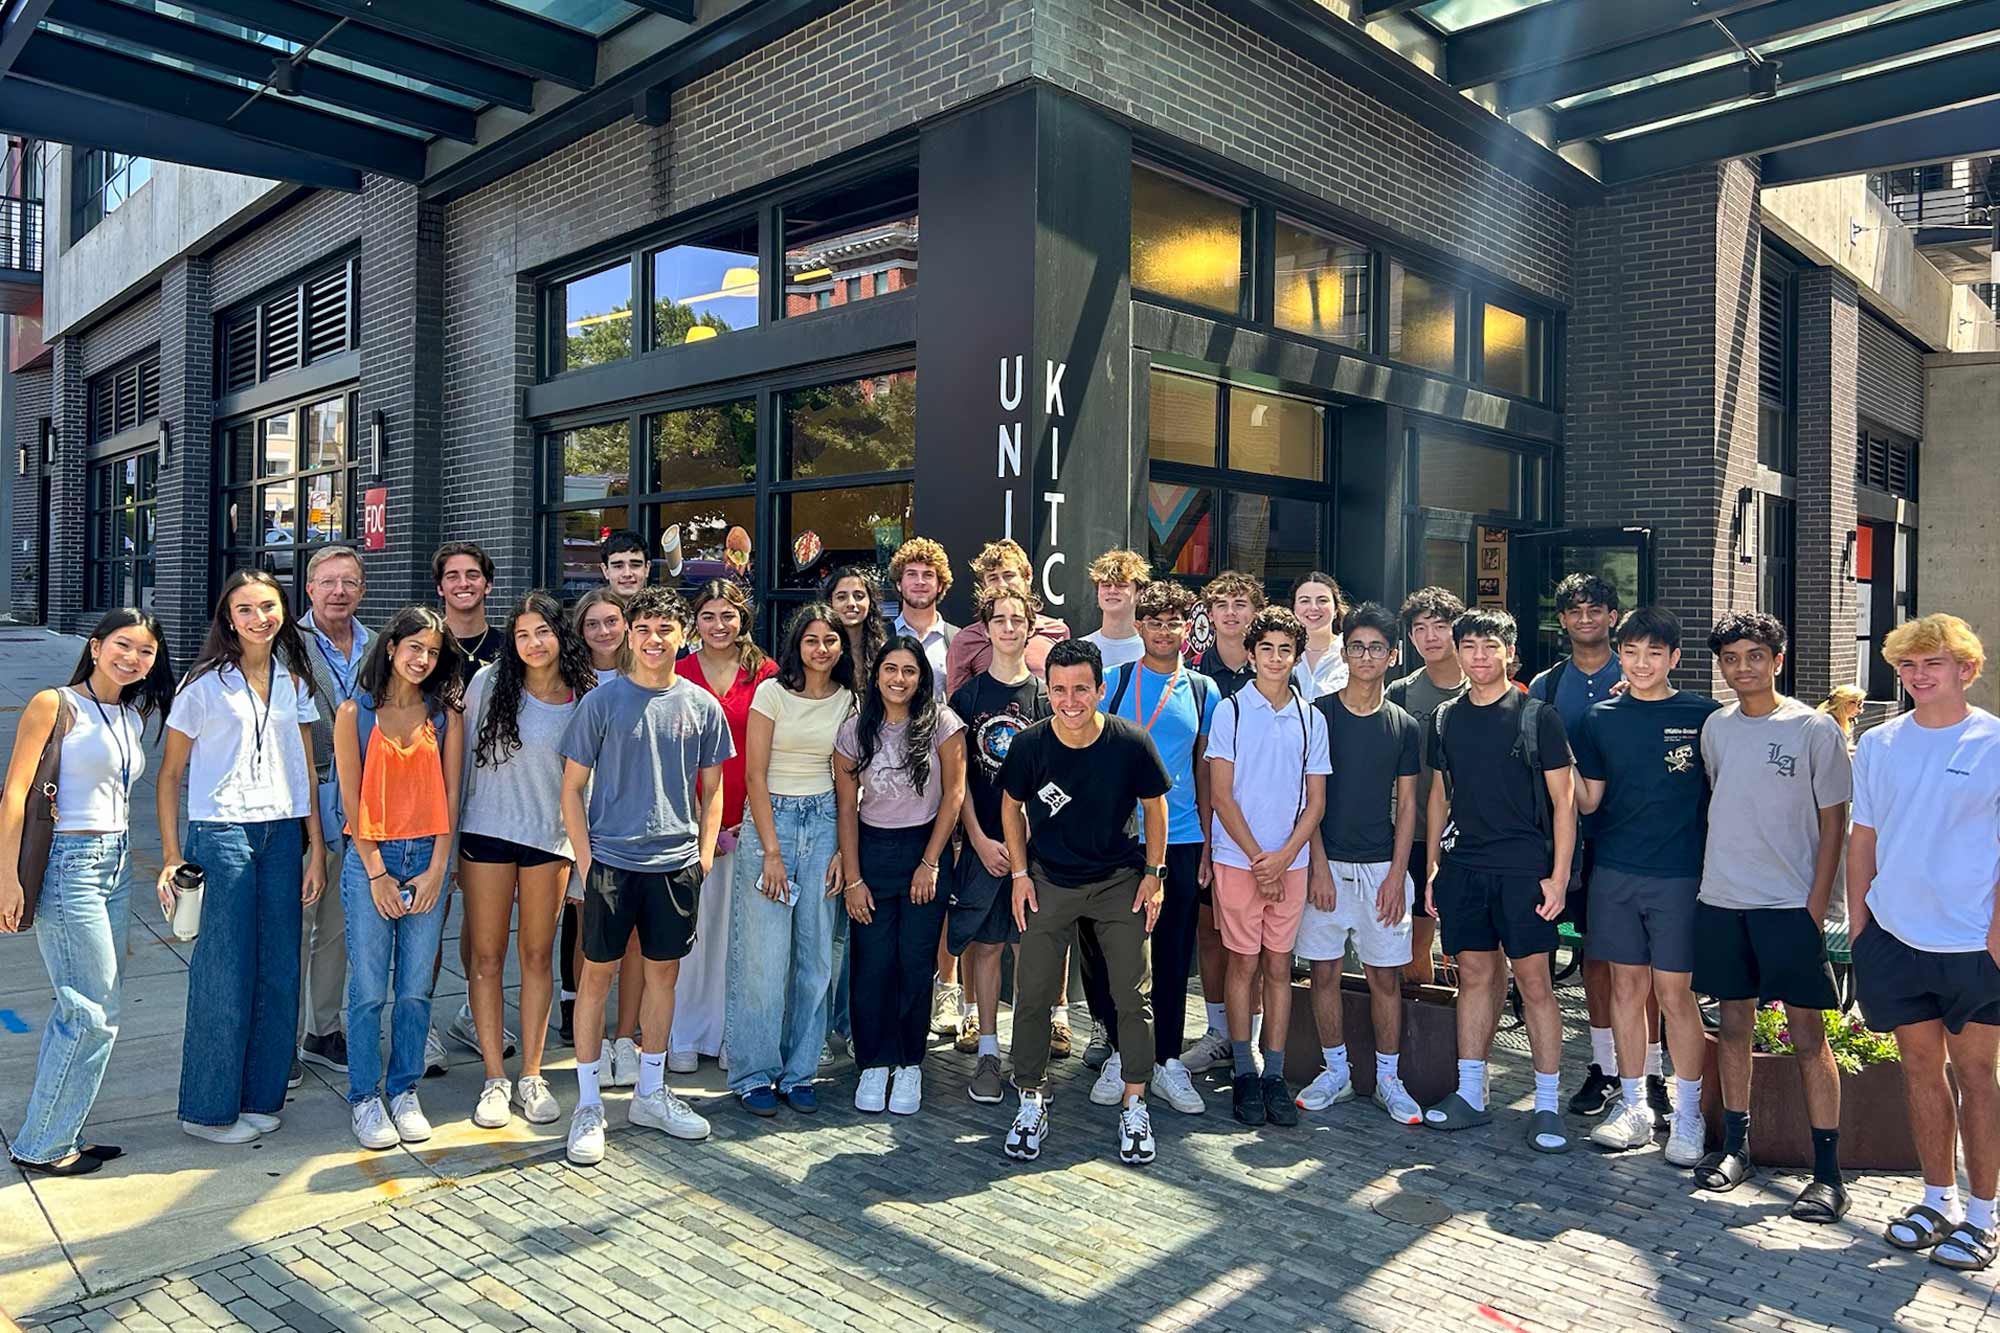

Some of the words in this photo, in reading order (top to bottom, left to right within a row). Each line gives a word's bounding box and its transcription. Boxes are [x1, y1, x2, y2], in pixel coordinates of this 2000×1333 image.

[364, 504, 385, 534] FDC
[997, 355, 1023, 540] UNI
[1042, 359, 1067, 606] KITC
